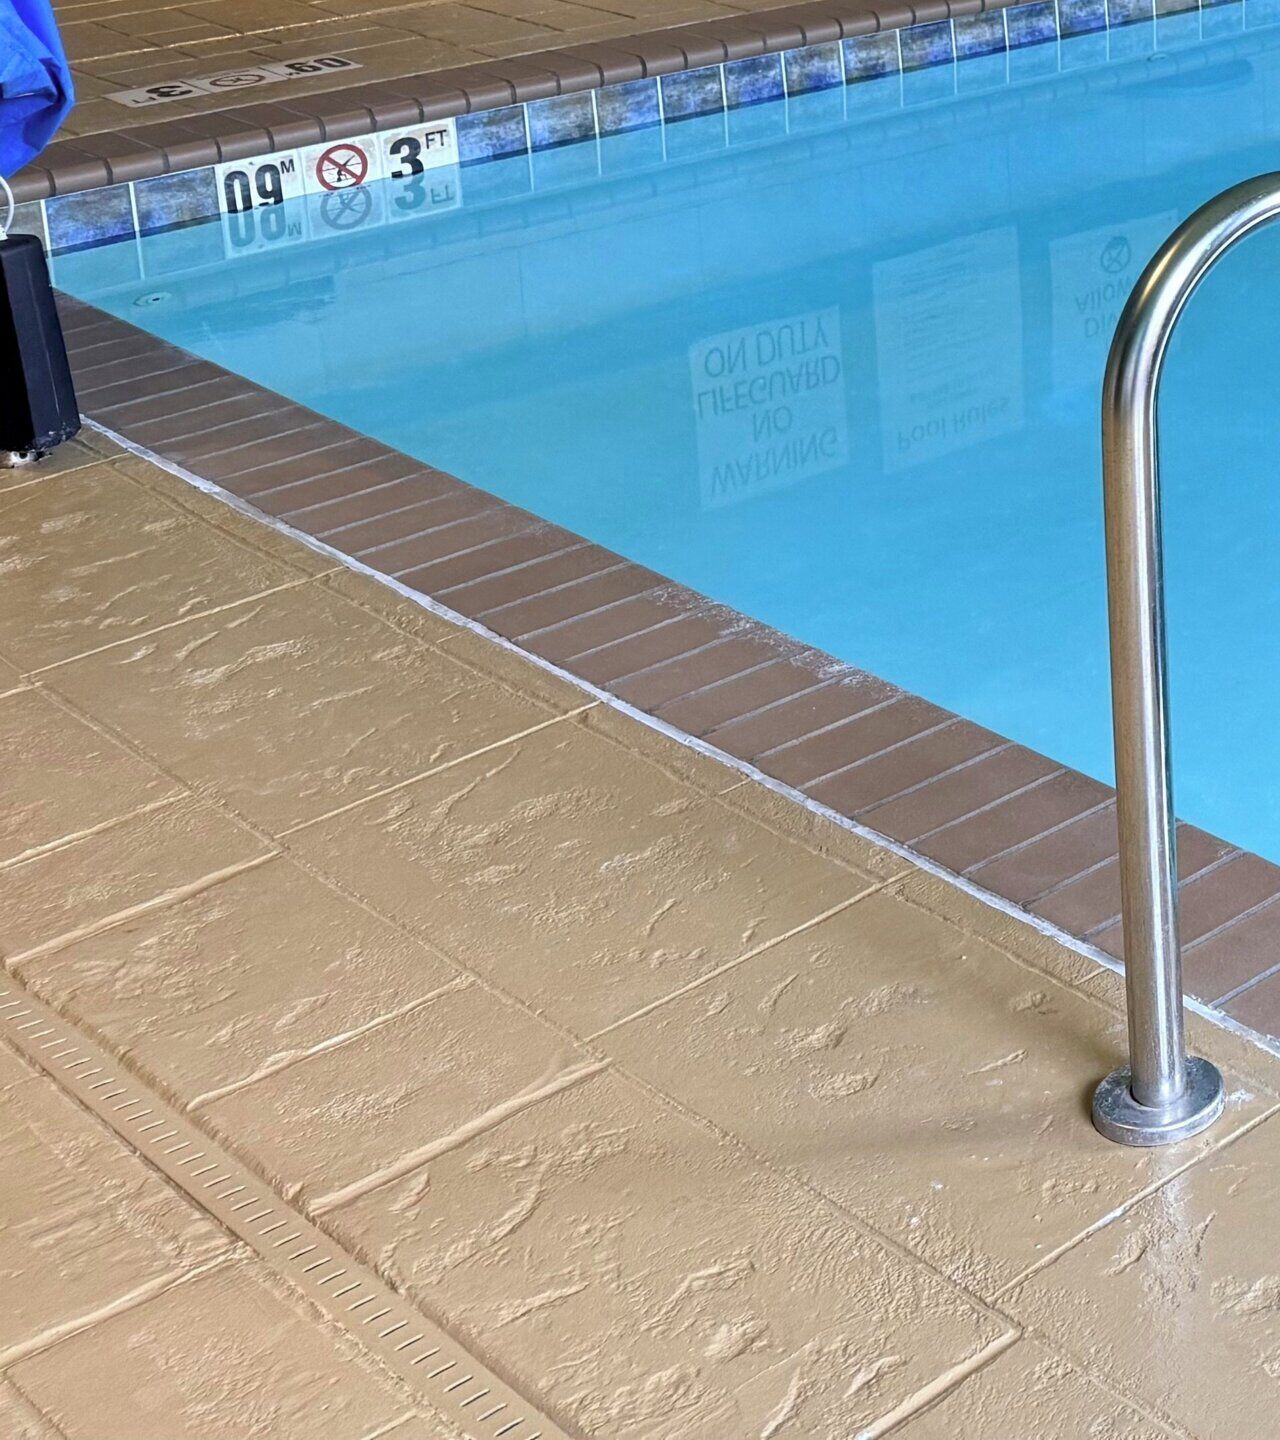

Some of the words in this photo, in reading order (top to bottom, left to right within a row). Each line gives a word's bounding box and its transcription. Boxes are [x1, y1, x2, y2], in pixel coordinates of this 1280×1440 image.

[280, 158, 296, 175] M
[389, 137, 425, 179] 3
[425, 129, 448, 150] FT
